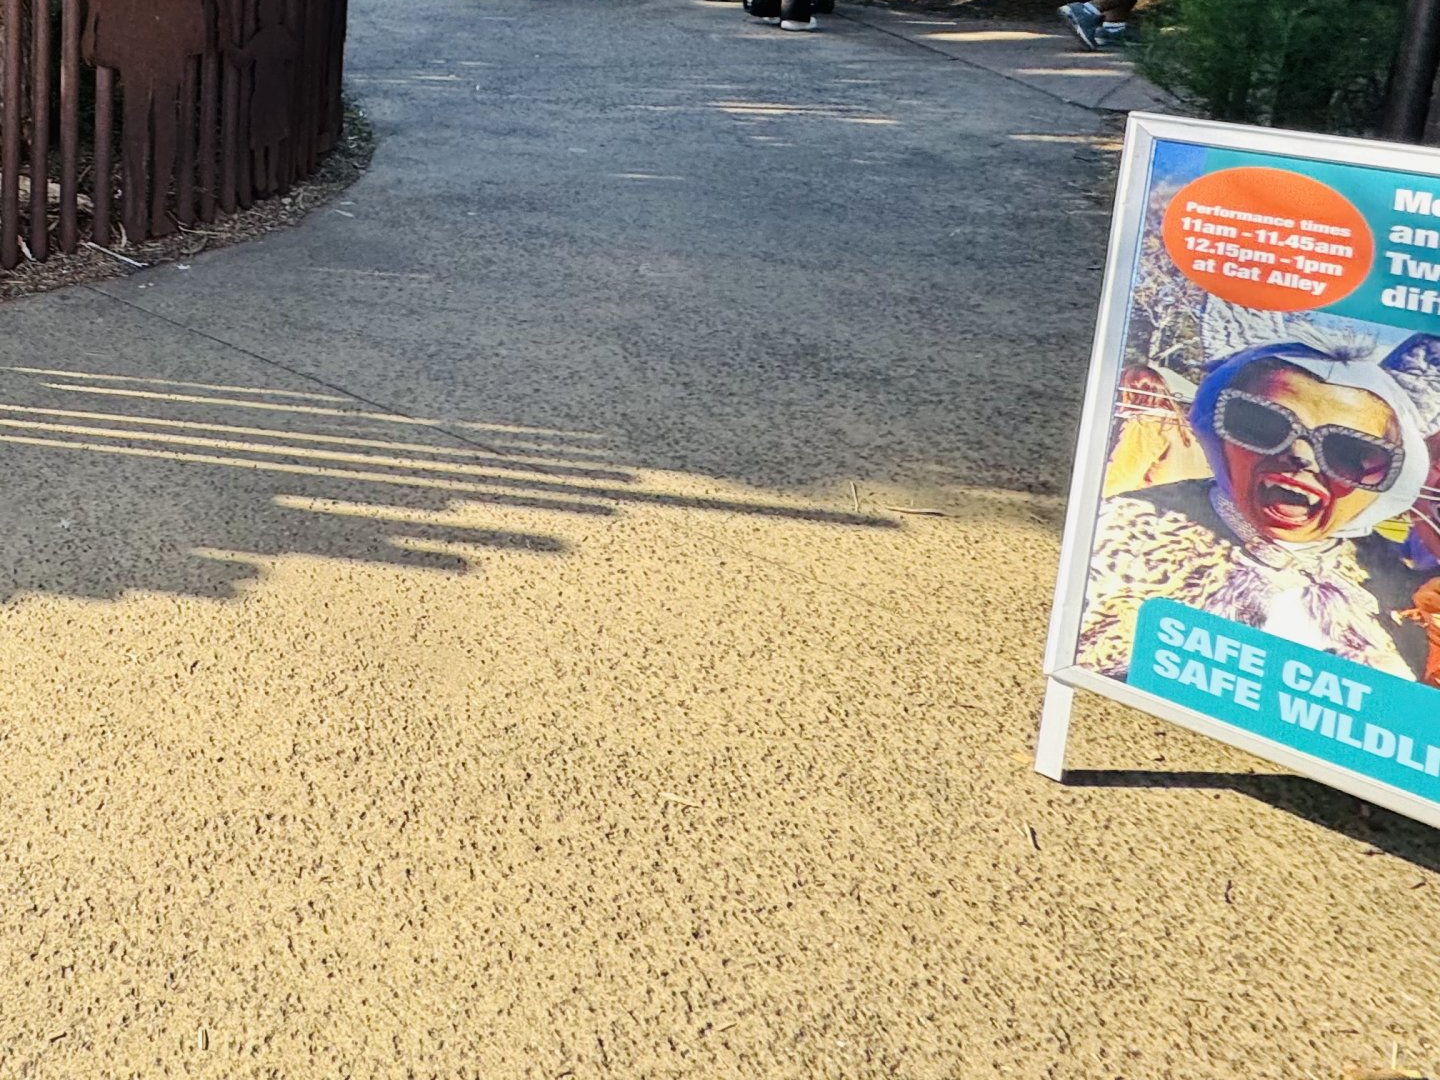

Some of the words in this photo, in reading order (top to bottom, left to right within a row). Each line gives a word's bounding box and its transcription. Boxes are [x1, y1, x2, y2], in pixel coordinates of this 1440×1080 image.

[1181, 216, 1238, 238] 11am
[1255, 228, 1353, 258] 11.45am
[1186, 201, 1295, 228] Performance
[1300, 220, 1352, 238] times
[1184, 236, 1276, 264] 12.15pm
[1293, 255, 1344, 276] 1pm
[1192, 258, 1217, 273] at
[1222, 261, 1262, 281] Cat
[1266, 270, 1328, 296] Alley
[1158, 616, 1267, 678] SAFE
[1281, 659, 1372, 712] CAT
[1152, 649, 1263, 711] SAFE
[1277, 691, 1440, 777] WILDLI
